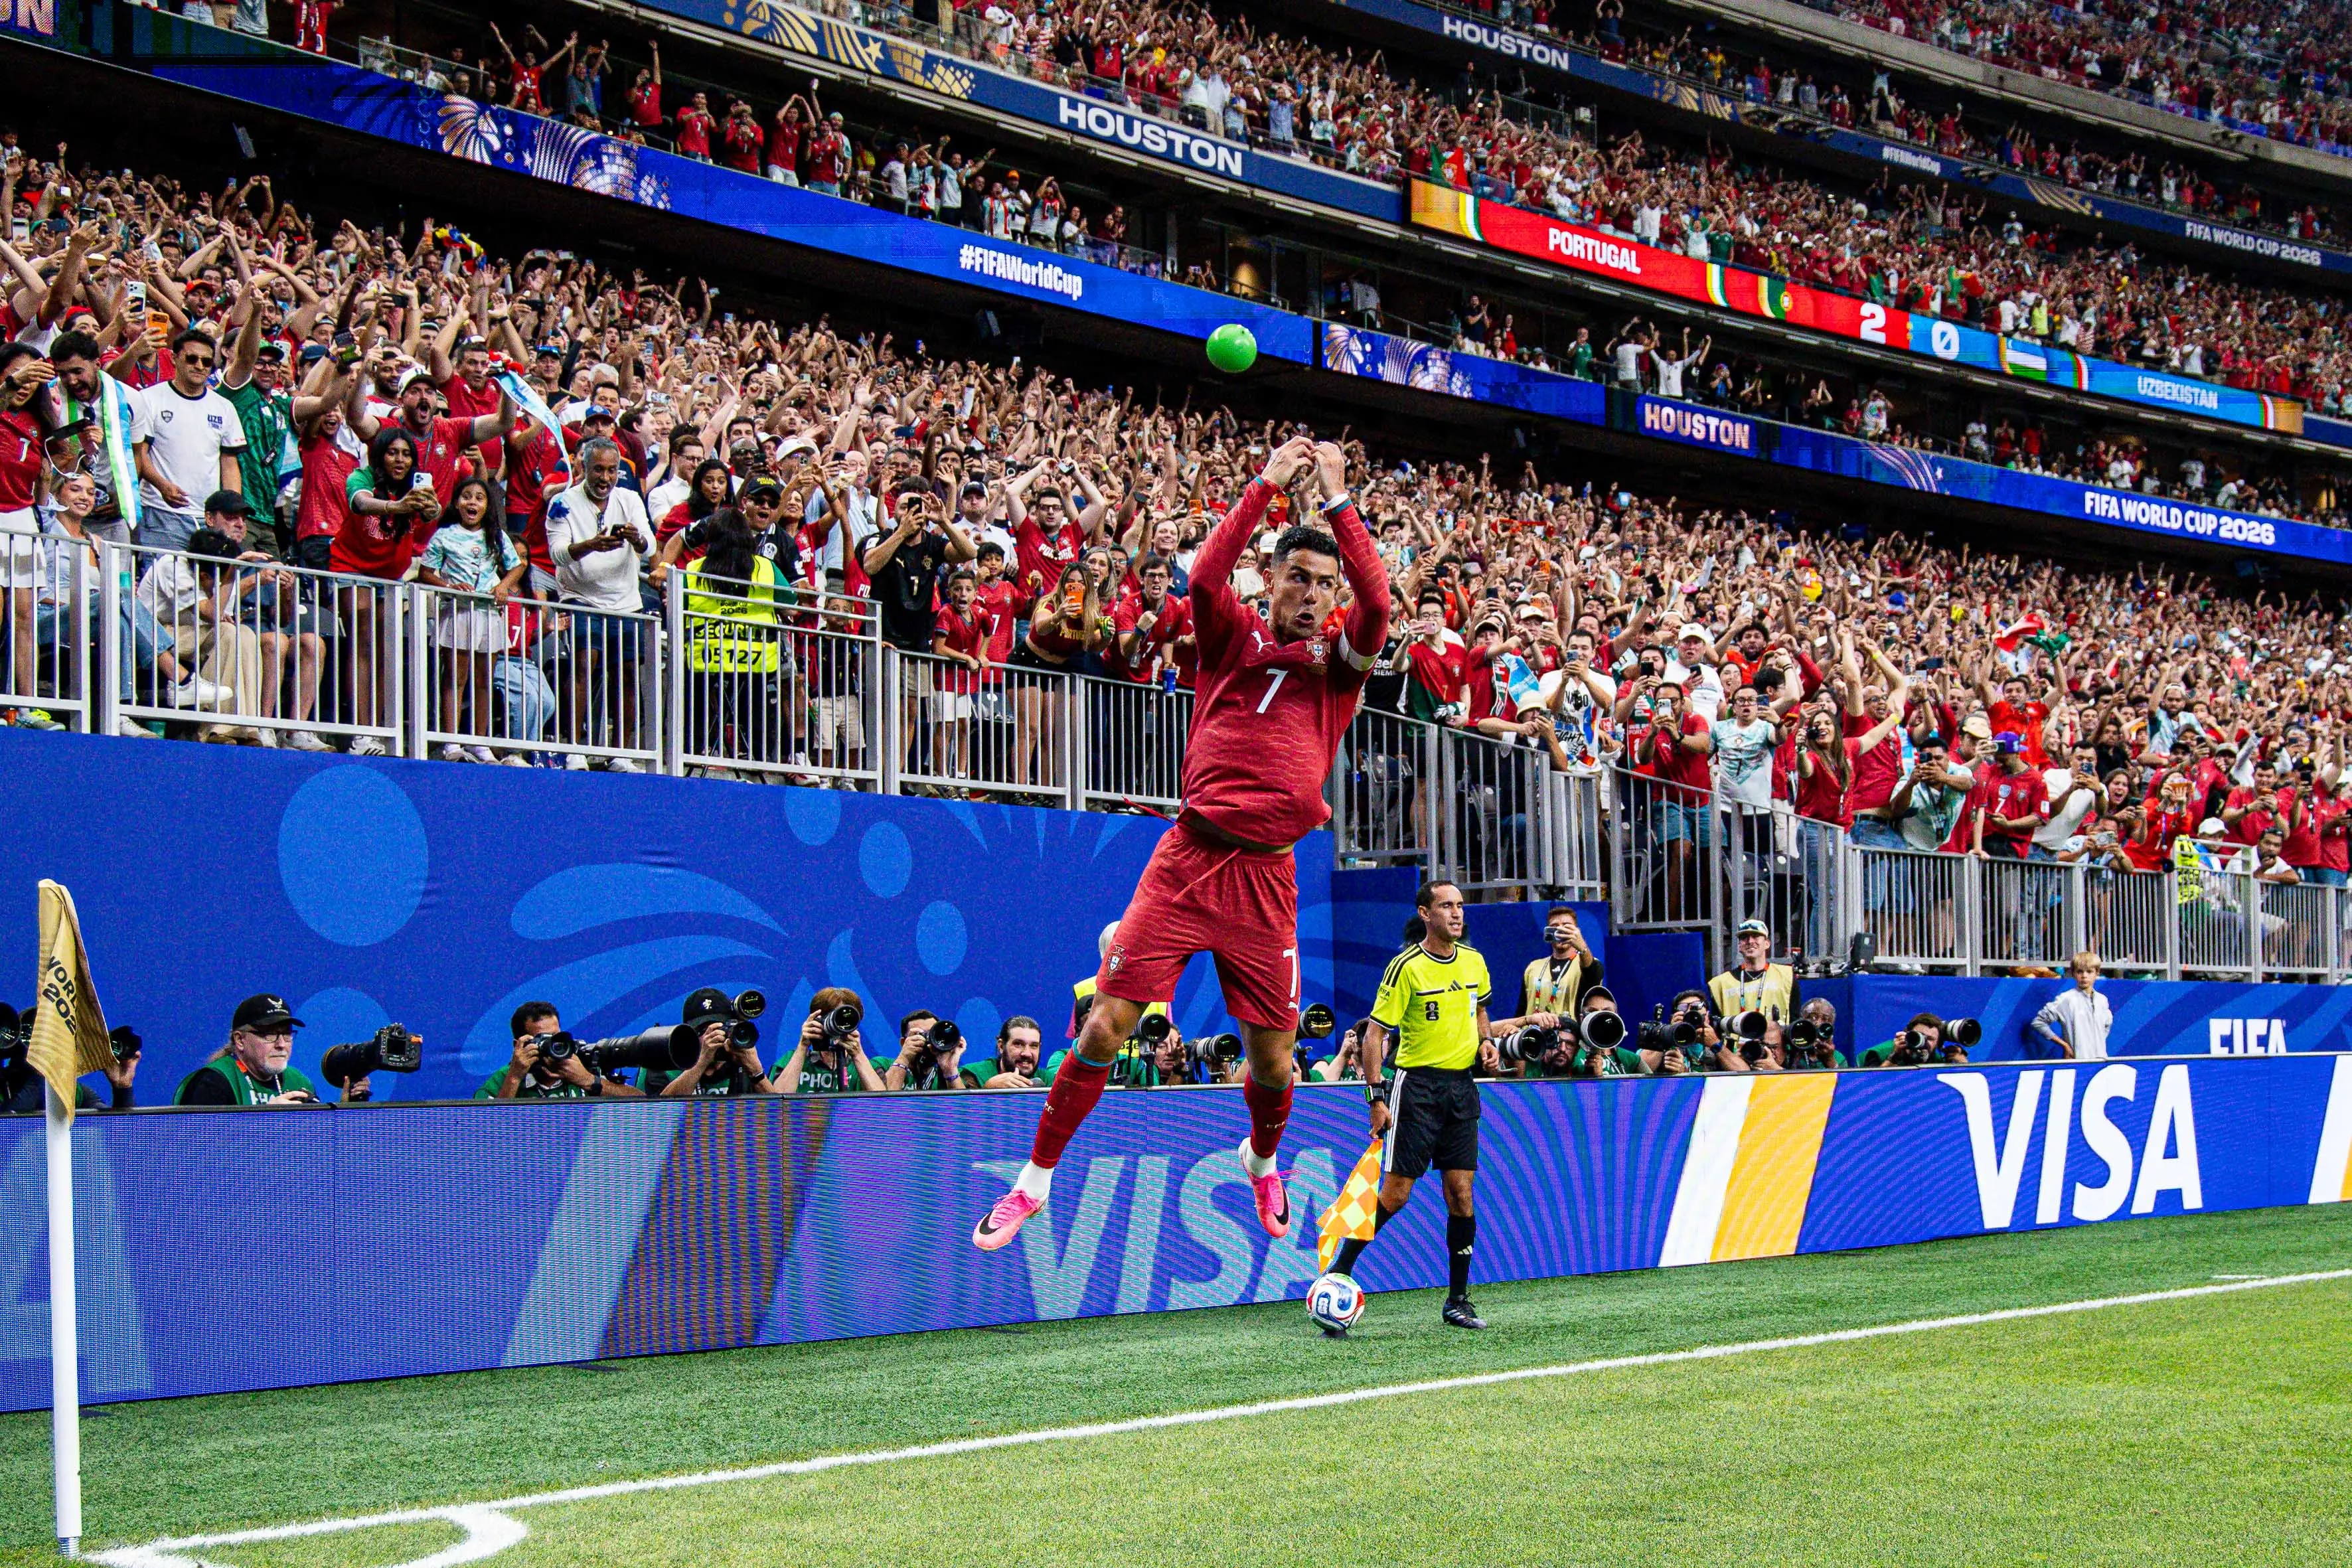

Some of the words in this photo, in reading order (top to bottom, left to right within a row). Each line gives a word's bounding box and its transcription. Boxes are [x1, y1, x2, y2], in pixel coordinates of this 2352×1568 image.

[1443, 15, 1569, 70] HOUSTON
[1059, 97, 1242, 177] HOUSTON
[1548, 227, 1642, 275] PORTUGAL
[2185, 221, 2212, 242] FIFA
[2213, 227, 2254, 252] WORLD
[2256, 238, 2280, 256] CUP
[2280, 243, 2322, 266] 2026
[959, 243, 1083, 301] #FIFAWorldCup
[1859, 302, 1887, 345] 2
[1931, 320, 1960, 360] 0
[2137, 375, 2218, 410] UZBEKISTAN
[207, 414, 223, 425] UZB
[1644, 402, 1751, 449] HOUSTON
[19, 437, 31, 462] 7
[2084, 491, 2121, 520] FIFA
[2120, 497, 2183, 530] WORLD
[2184, 509, 2218, 536] CUP
[2218, 515, 2276, 546] 2026
[909, 575, 919, 596] 7
[511, 625, 521, 647] 7
[991, 613, 1001, 635] 7
[701, 647, 762, 665] 05127
[1256, 668, 1289, 714] 7
[1283, 947, 1297, 998] 7
[1379, 986, 1391, 997] FIFA
[42, 982, 78, 1036] 202
[2209, 1018, 2287, 1055] FIFA
[1937, 1063, 2203, 1229] VISA
[972, 1148, 1348, 1320] VISA
